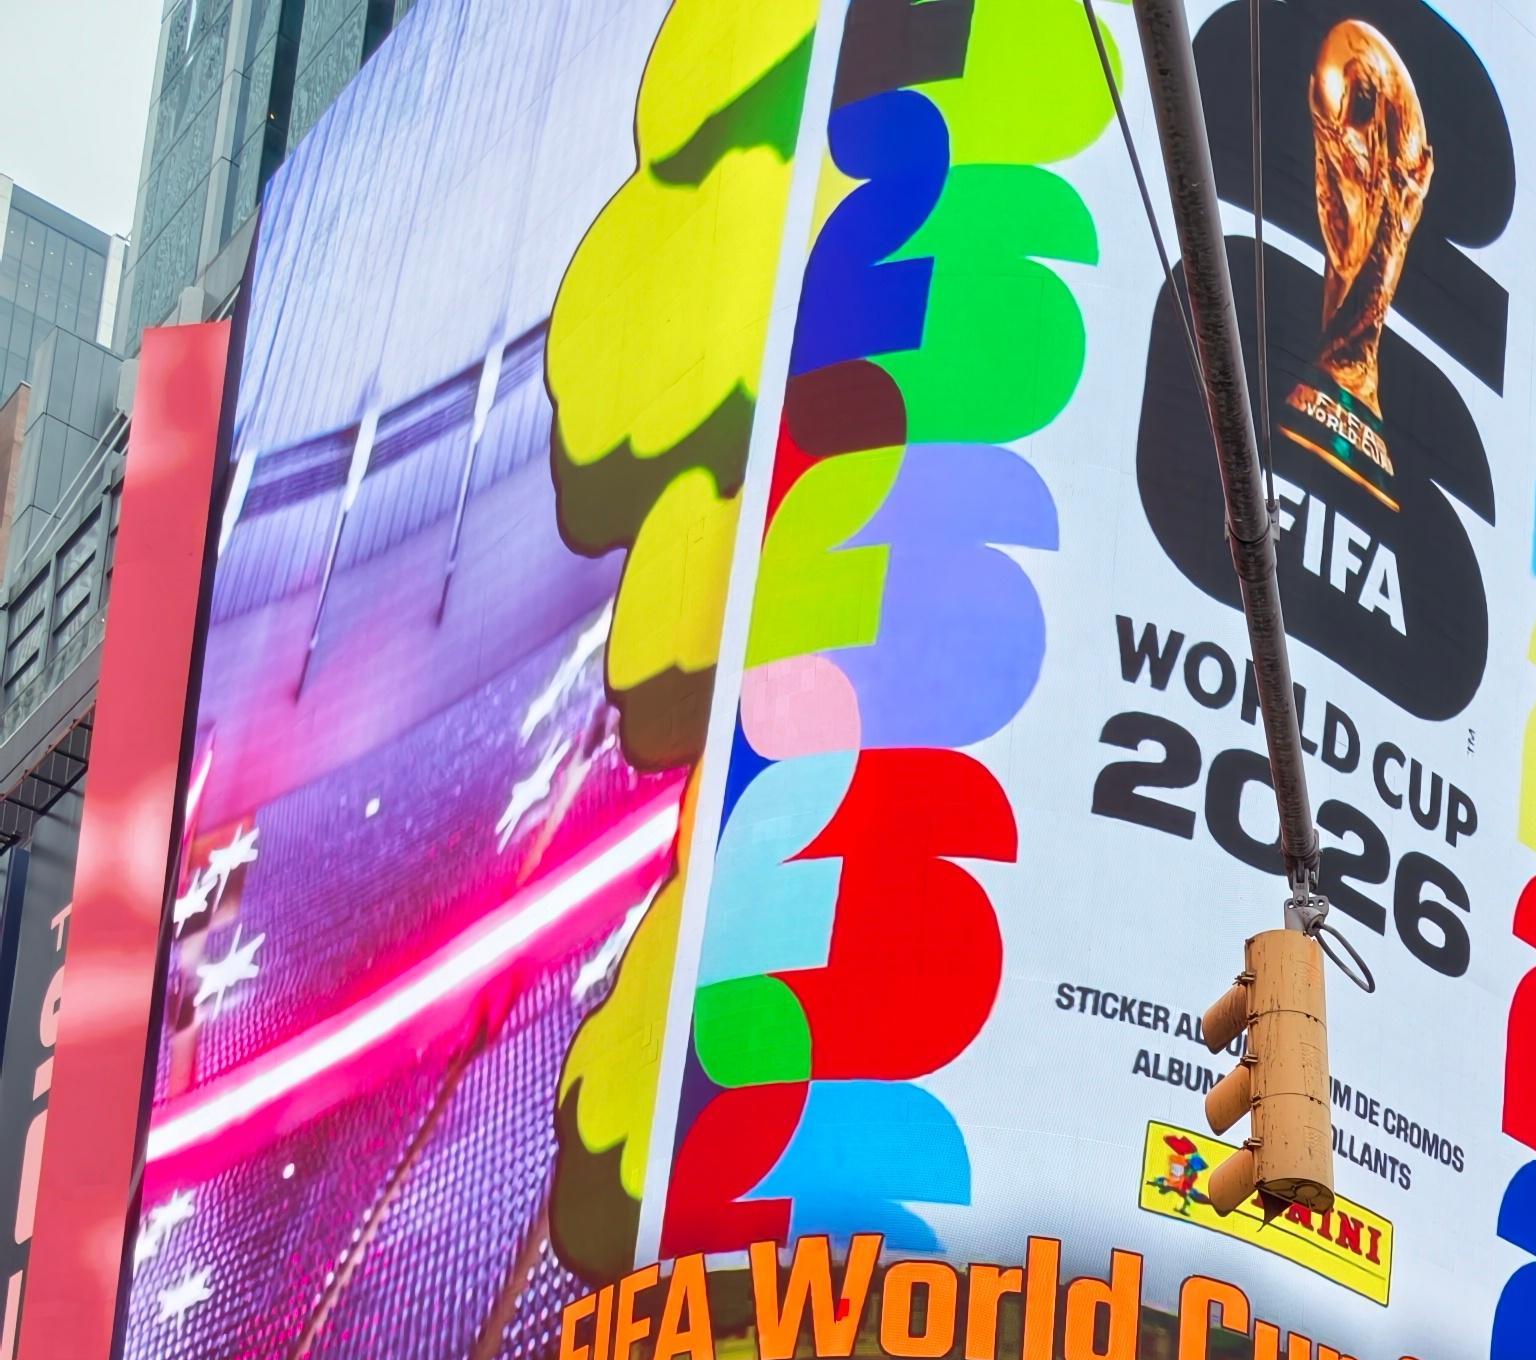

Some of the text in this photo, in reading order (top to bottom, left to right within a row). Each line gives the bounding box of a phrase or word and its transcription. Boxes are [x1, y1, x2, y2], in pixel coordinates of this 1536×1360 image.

[1373, 743, 1478, 847] CUP
[1091, 710, 1472, 978] 2026
[1055, 983, 1170, 1033] STICKER
[1355, 1090, 1380, 1126] DE
[1383, 1107, 1466, 1174] CROMOS
